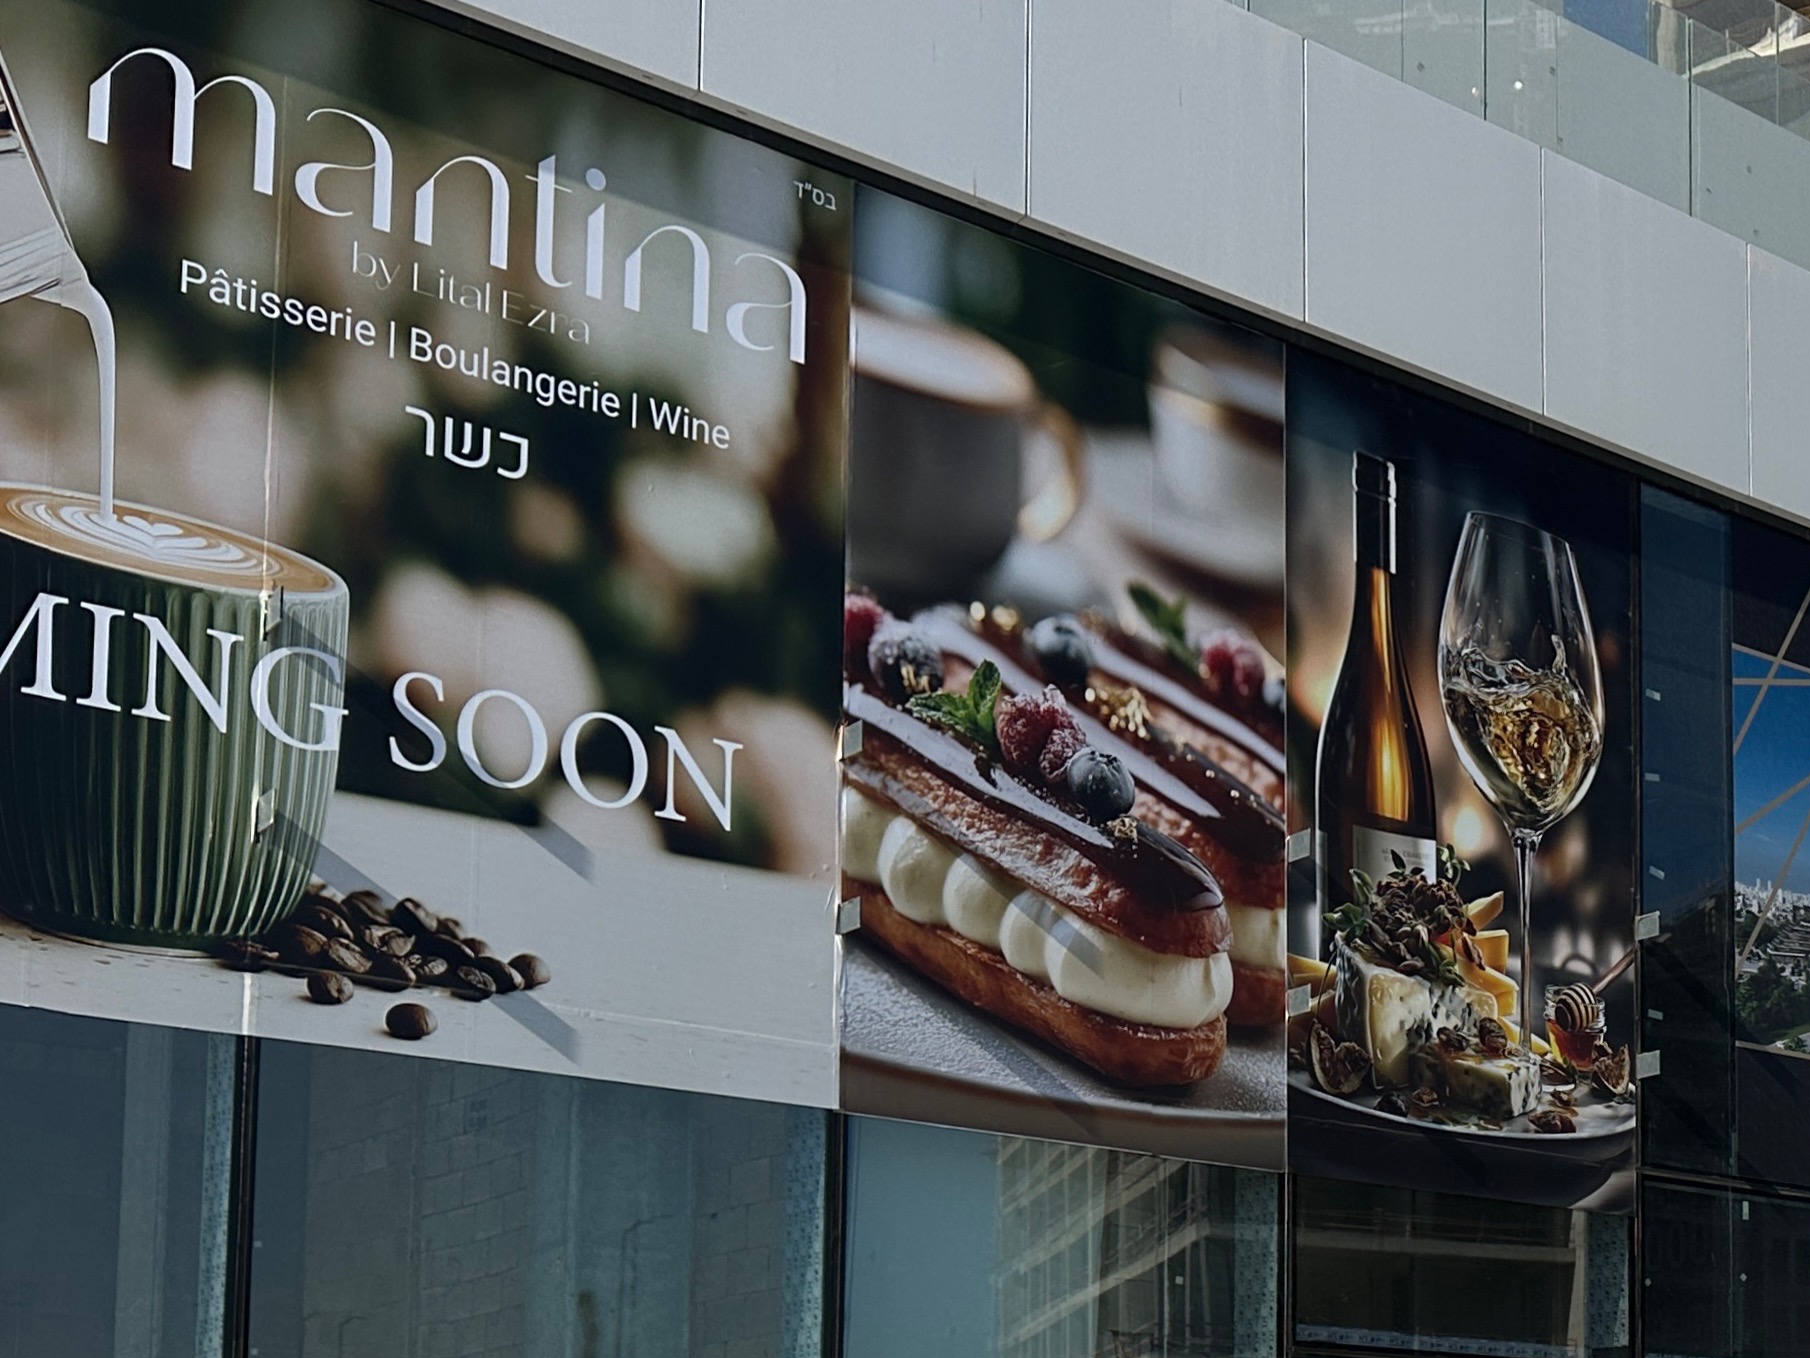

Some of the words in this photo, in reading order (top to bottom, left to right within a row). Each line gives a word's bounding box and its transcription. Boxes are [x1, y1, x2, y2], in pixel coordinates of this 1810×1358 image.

[88, 47, 806, 364] mantina
[180, 259, 376, 347] Pâtisserie
[410, 327, 621, 418] Boulangerie
[649, 397, 731, 450] Wine
[353, 240, 400, 291] by
[414, 262, 491, 314] Lital
[502, 290, 590, 345] Ezra
[405, 405, 530, 480] כשר
[388, 671, 744, 832] SOON
